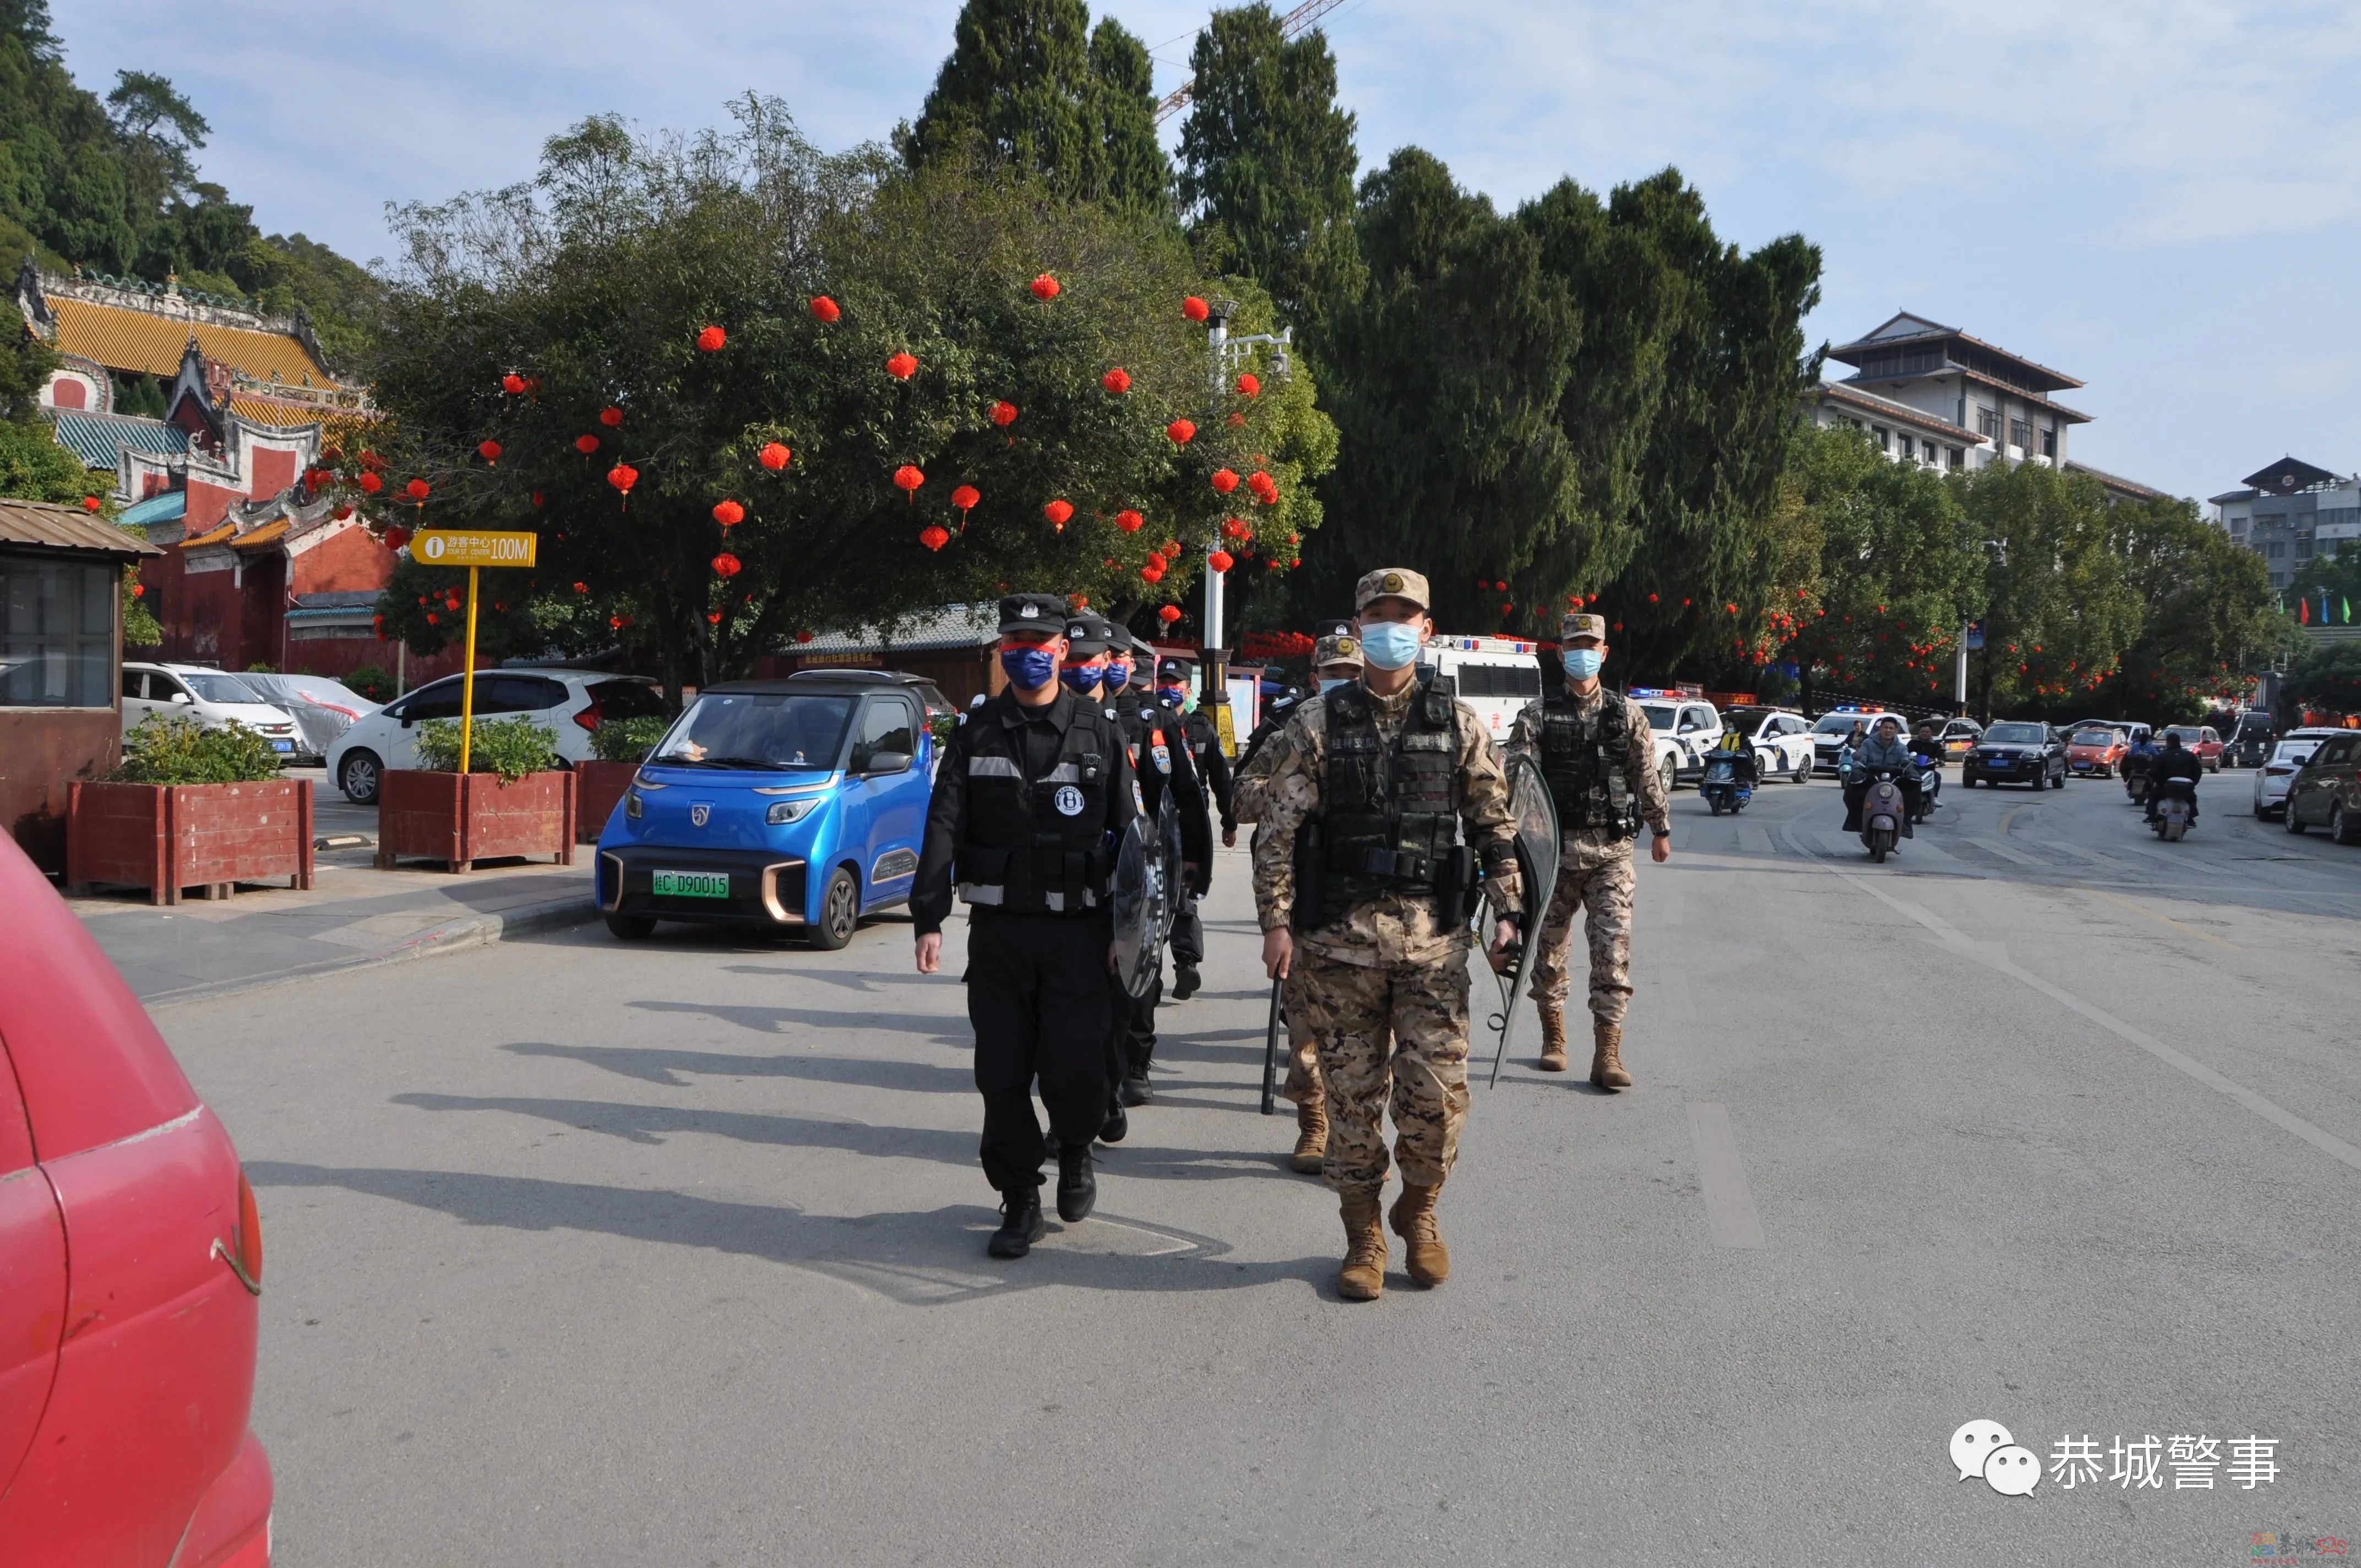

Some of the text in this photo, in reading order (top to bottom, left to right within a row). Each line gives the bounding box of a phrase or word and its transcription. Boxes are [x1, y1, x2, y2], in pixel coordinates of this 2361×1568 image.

[447, 536, 490, 548] 游客中心
[491, 538, 528, 560] 100M
[1492, 712, 1500, 730] 武
[1152, 856, 1163, 956] POLICE
